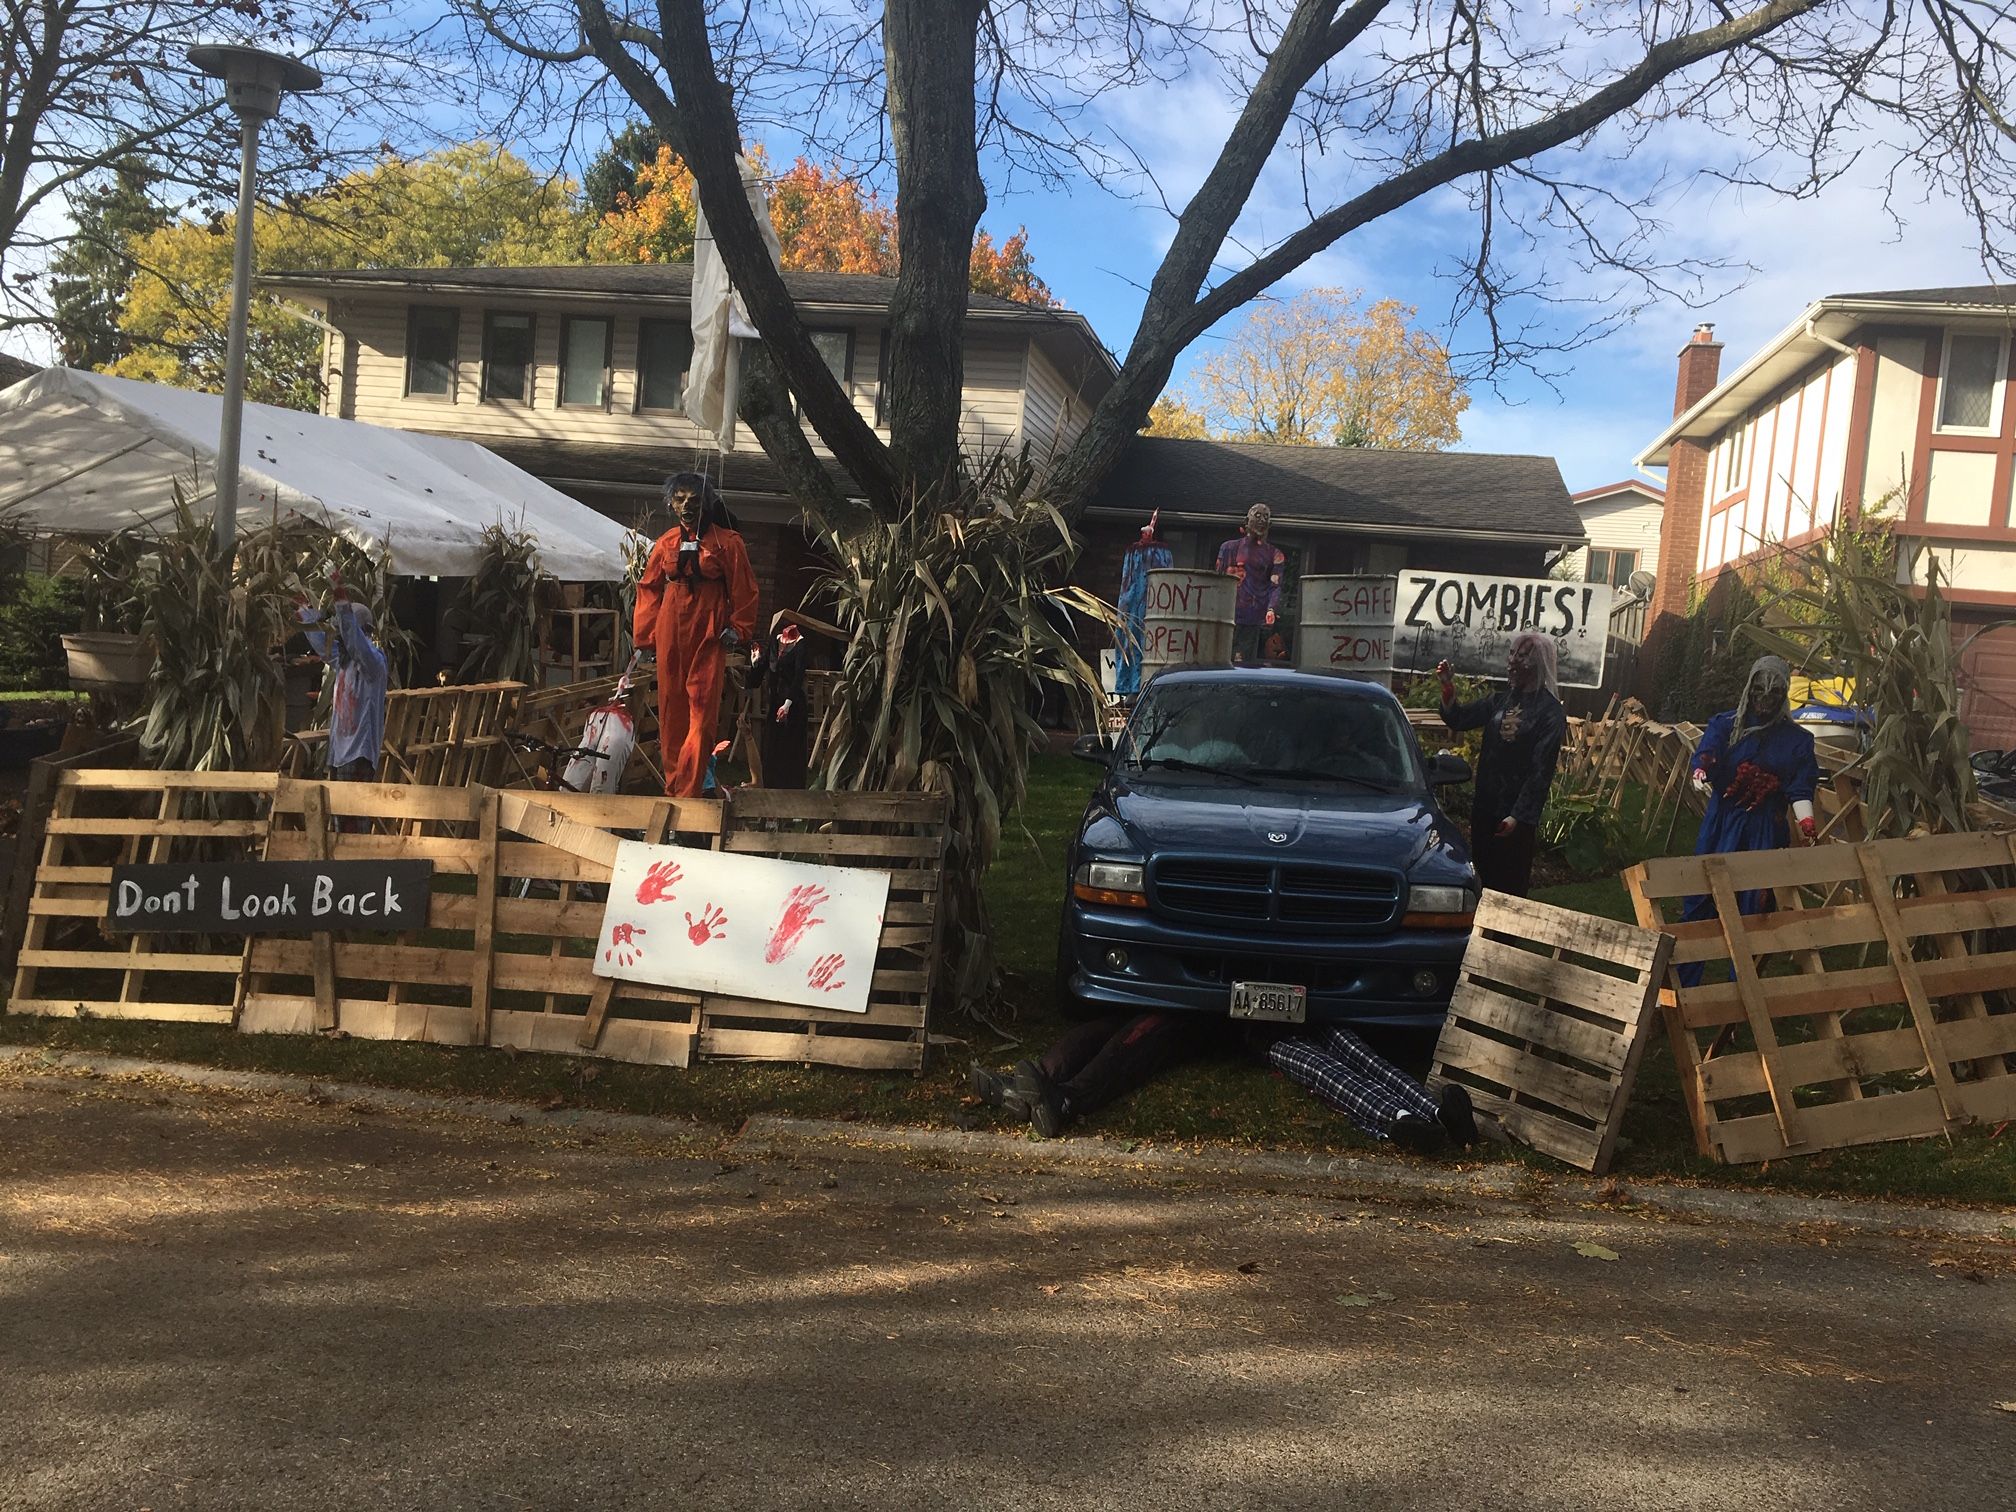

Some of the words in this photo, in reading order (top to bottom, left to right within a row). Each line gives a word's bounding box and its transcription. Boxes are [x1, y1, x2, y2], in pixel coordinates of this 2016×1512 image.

[1147, 576, 1212, 614] DON'T
[1330, 586, 1391, 616] SAFE
[1405, 577, 1593, 637] ZOMBIES!
[1144, 626, 1199, 656] OPEN
[1330, 635, 1390, 663] ZONE
[116, 874, 199, 917] Dont
[221, 875, 297, 920] Look
[312, 875, 402, 917] Back
[1260, 993, 1303, 1013] 85617
